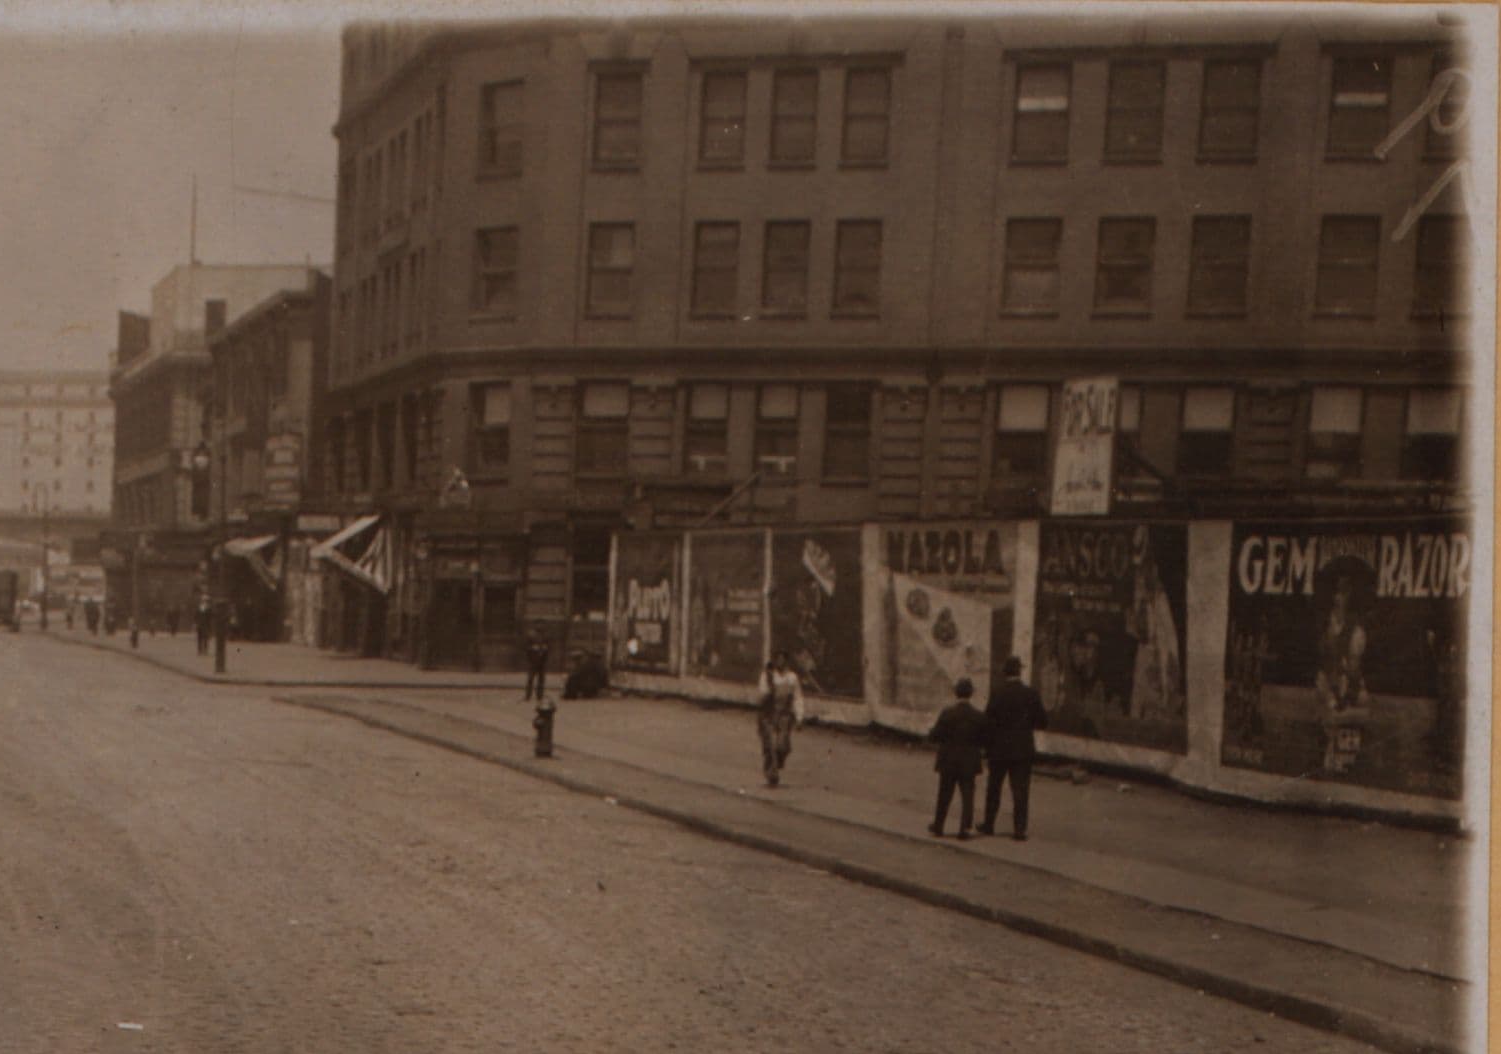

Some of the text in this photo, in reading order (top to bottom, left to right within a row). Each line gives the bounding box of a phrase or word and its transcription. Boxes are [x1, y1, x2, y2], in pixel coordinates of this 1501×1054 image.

[886, 528, 1006, 575] MAZOLA
[1043, 530, 1129, 579] ANSCO
[1238, 536, 1317, 596] GEM
